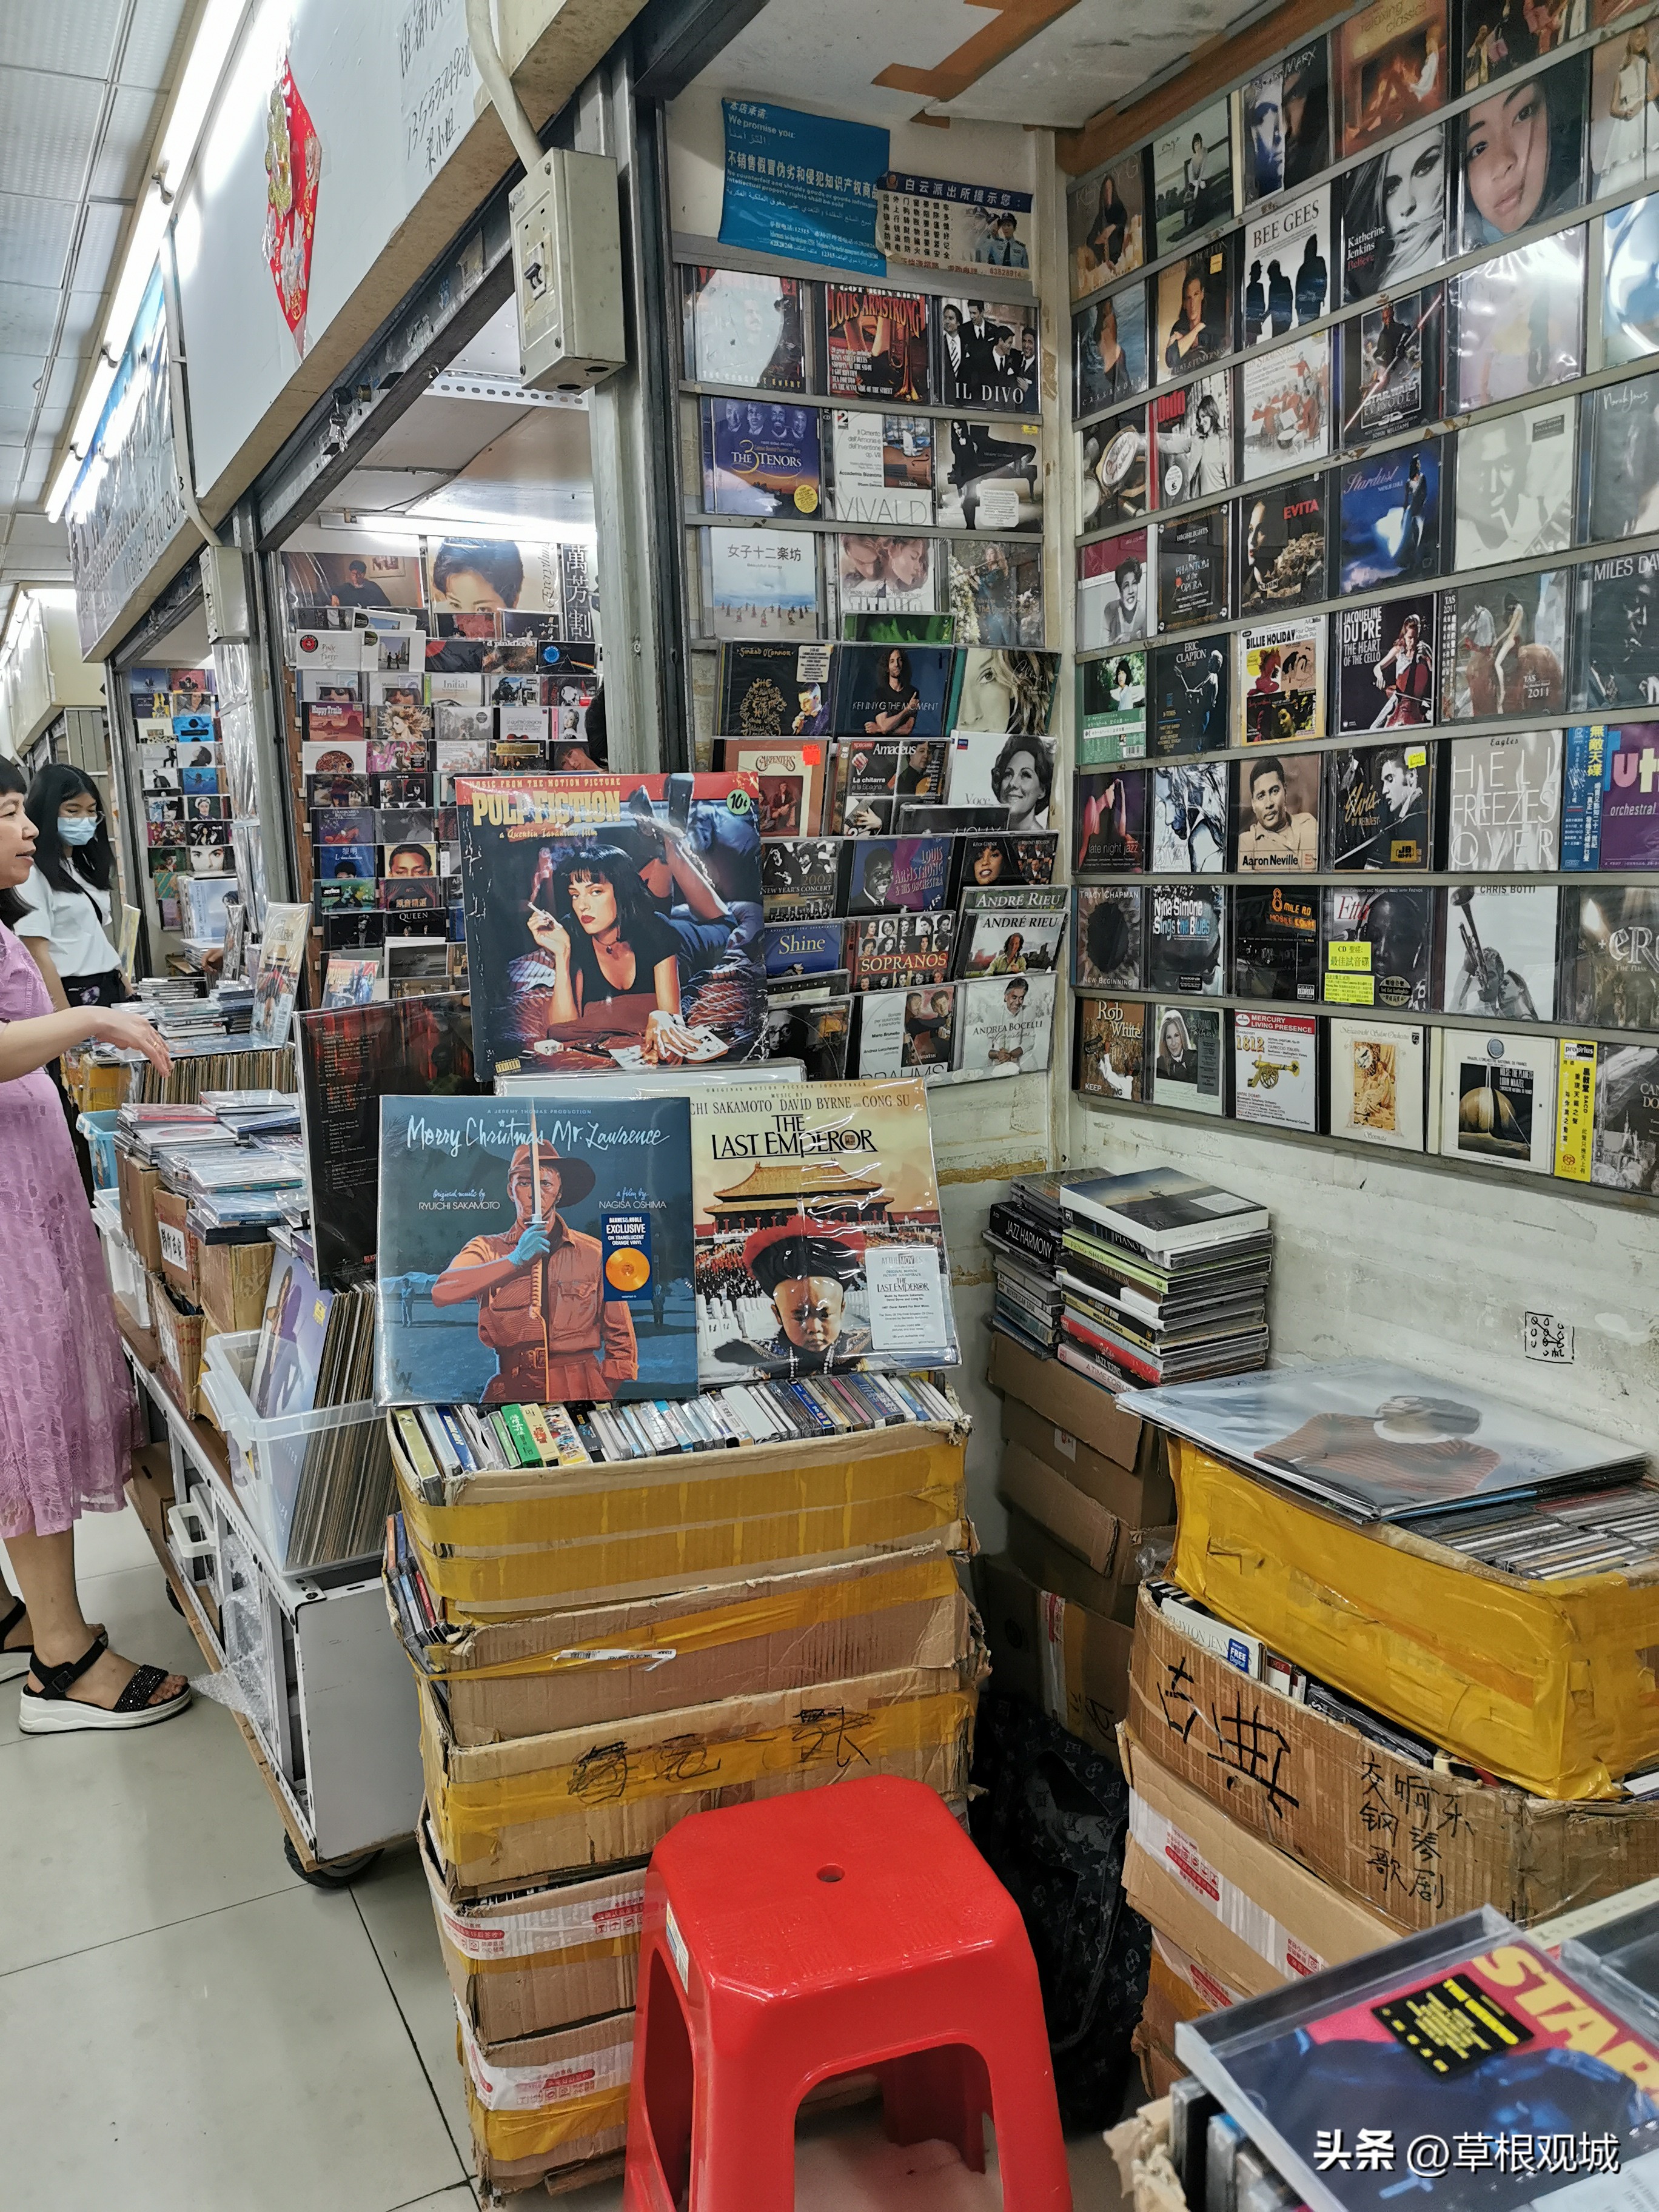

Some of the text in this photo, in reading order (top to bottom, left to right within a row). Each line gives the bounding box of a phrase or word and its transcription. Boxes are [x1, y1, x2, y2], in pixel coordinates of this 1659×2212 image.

[743, 120, 776, 135] promise
[1253, 200, 1319, 249] BEE GEES
[1348, 225, 1386, 249] Katherine
[1347, 243, 1375, 261] Jenkins
[830, 292, 926, 338] LOUIS ARMSTRONG
[956, 382, 1024, 404] IL DIVO
[731, 452, 802, 468] THE TENORS
[837, 496, 933, 525] VIVALDI
[1283, 498, 1319, 520] EVITA
[1177, 527, 1208, 541] HIGHLIGHTS
[728, 544, 801, 561] 女子十二楽坊
[1175, 559, 1209, 576] PHANTOM
[1594, 558, 1633, 581] MILES
[1445, 595, 1456, 605] TAS
[1343, 606, 1382, 625] JACQUELINE
[1246, 629, 1296, 649] BILLIE HOLIDAY
[1344, 626, 1358, 643] DU
[1184, 640, 1199, 651] ERIC
[1344, 638, 1381, 656] THE HEART
[1176, 649, 1207, 663] CLAPTON
[1343, 651, 1381, 667] OF THE CELLO
[443, 679, 468, 689] Initial
[1528, 687, 1550, 698] 2011
[853, 701, 939, 711] KENNY G THE MOMENT
[873, 743, 917, 756] Amadeus
[1490, 737, 1519, 747] Eagles
[756, 755, 796, 772] CARPENTERS
[501, 780, 523, 788] FROM
[548, 779, 580, 787] MOTION
[585, 777, 621, 786] PICTURE
[472, 790, 621, 826] PULP FICTION
[1344, 782, 1382, 823] Elvis
[1452, 789, 1555, 828] FREEZES
[1610, 802, 1657, 816] orchestral
[508, 828, 538, 839] Quentin
[541, 828, 578, 838] Tarantino
[581, 828, 598, 837] film
[1103, 841, 1138, 856] night jazz
[1450, 828, 1553, 866] OVER
[1242, 854, 1298, 865] Aaron Neville
[1104, 890, 1139, 899] CHAPMAN
[1480, 885, 1536, 894] CHRIS BOTTI
[976, 893, 1061, 907] ANDRÉ RIEU
[1153, 898, 1202, 916] Nina Simone
[1272, 888, 1299, 914] 8 MILE
[1337, 896, 1370, 920] Etta
[983, 916, 1059, 928] ANDRÉ RIEU
[1153, 917, 1210, 940] Sings the Blues
[779, 935, 825, 954] Shine
[861, 953, 947, 972] SOPRANOS
[1098, 977, 1132, 986] BEGINNING
[1097, 1000, 1124, 1021] Rob
[973, 1020, 1043, 1034] ANDREA BOCELLI
[1252, 1015, 1285, 1024] MERCURY
[1110, 1020, 1142, 1039] White
[1275, 1024, 1312, 1033] PRESENCE
[1236, 1035, 1265, 1053] 1812
[1566, 1047, 1594, 1055] proprius
[713, 1094, 910, 1114] SAKAMOTO DAVID BYRNE CONG SU
[771, 1114, 806, 1133] THE
[407, 1115, 671, 1157] Merry Christmas Mr. Lawrence
[712, 1129, 879, 1161] LAST EMPEROR
[622, 1187, 638, 1200] film
[418, 1201, 500, 1210] RYUICHI SAKAMOTO
[599, 1201, 667, 1210] NAGISA OSHIMA
[606, 1224, 646, 1234] EXCLUSIVE
[1005, 1220, 1053, 1259] JAZZ HARMONY
[1114, 1234, 1140, 1252] PIANO
[877, 1282, 930, 1292] LAST EMPEROR
[1114, 1272, 1131, 1287] MUSIC
[1094, 1353, 1107, 1367] JAZZ
[1091, 1366, 1108, 1381] TIME
[1229, 1655, 1245, 1669] Digital
[1230, 1647, 1247, 1661] FREE
